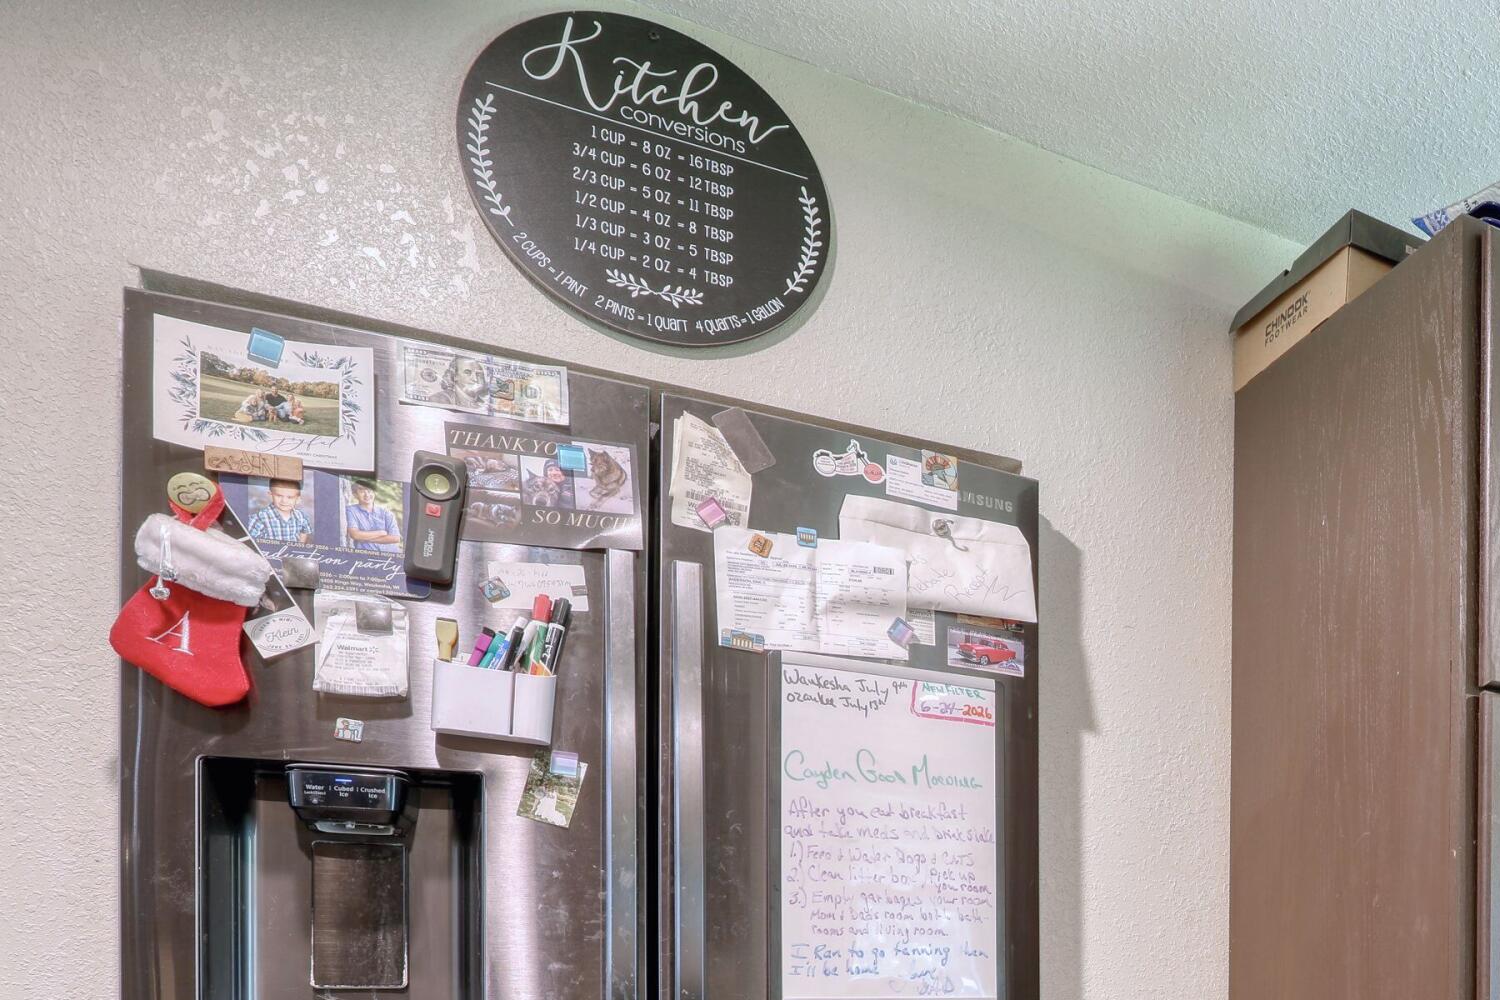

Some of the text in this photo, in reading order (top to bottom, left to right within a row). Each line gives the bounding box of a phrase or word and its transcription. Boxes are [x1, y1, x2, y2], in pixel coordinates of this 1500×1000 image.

[522, 16, 790, 145] Kitchen
[620, 105, 746, 154] conversions
[572, 143, 734, 198] 3/4 CUP 6 OZ 12 TBSP
[591, 125, 734, 177] 1 CUP 8 OZ 16 TBSP
[572, 167, 734, 221] 2/3 CUP 5 OZ 11 TBSP
[575, 190, 734, 243] 1/2 CUP 4 OZ 8 TBSP
[576, 214, 733, 265] 1/3 CUP 3 OZ 5 TBSP
[513, 232, 589, 297] 2 CUPS 1 PINT
[574, 237, 733, 288] 1/4 CUP 2 OZ 4 TBSP
[594, 295, 605, 308] 2
[605, 299, 635, 320] PINTS
[647, 313, 653, 326] 1
[695, 320, 703, 333] 4
[745, 312, 755, 324] 1
[1264, 306, 1308, 348] FOOTWEAR
[1265, 291, 1308, 337] CHINOOK
[450, 429, 558, 456] THANK YO
[532, 509, 561, 525] SO
[959, 490, 1013, 513] MSUNG
[349, 558, 406, 581] party
[144, 609, 194, 656] A
[265, 627, 299, 643] Klein
[336, 644, 368, 652] Walmart
[783, 668, 851, 693] Waukesha
[855, 679, 889, 703] July
[840, 696, 868, 720] July
[783, 749, 857, 790] Cayden
[788, 796, 969, 825] After you eat breakfast
